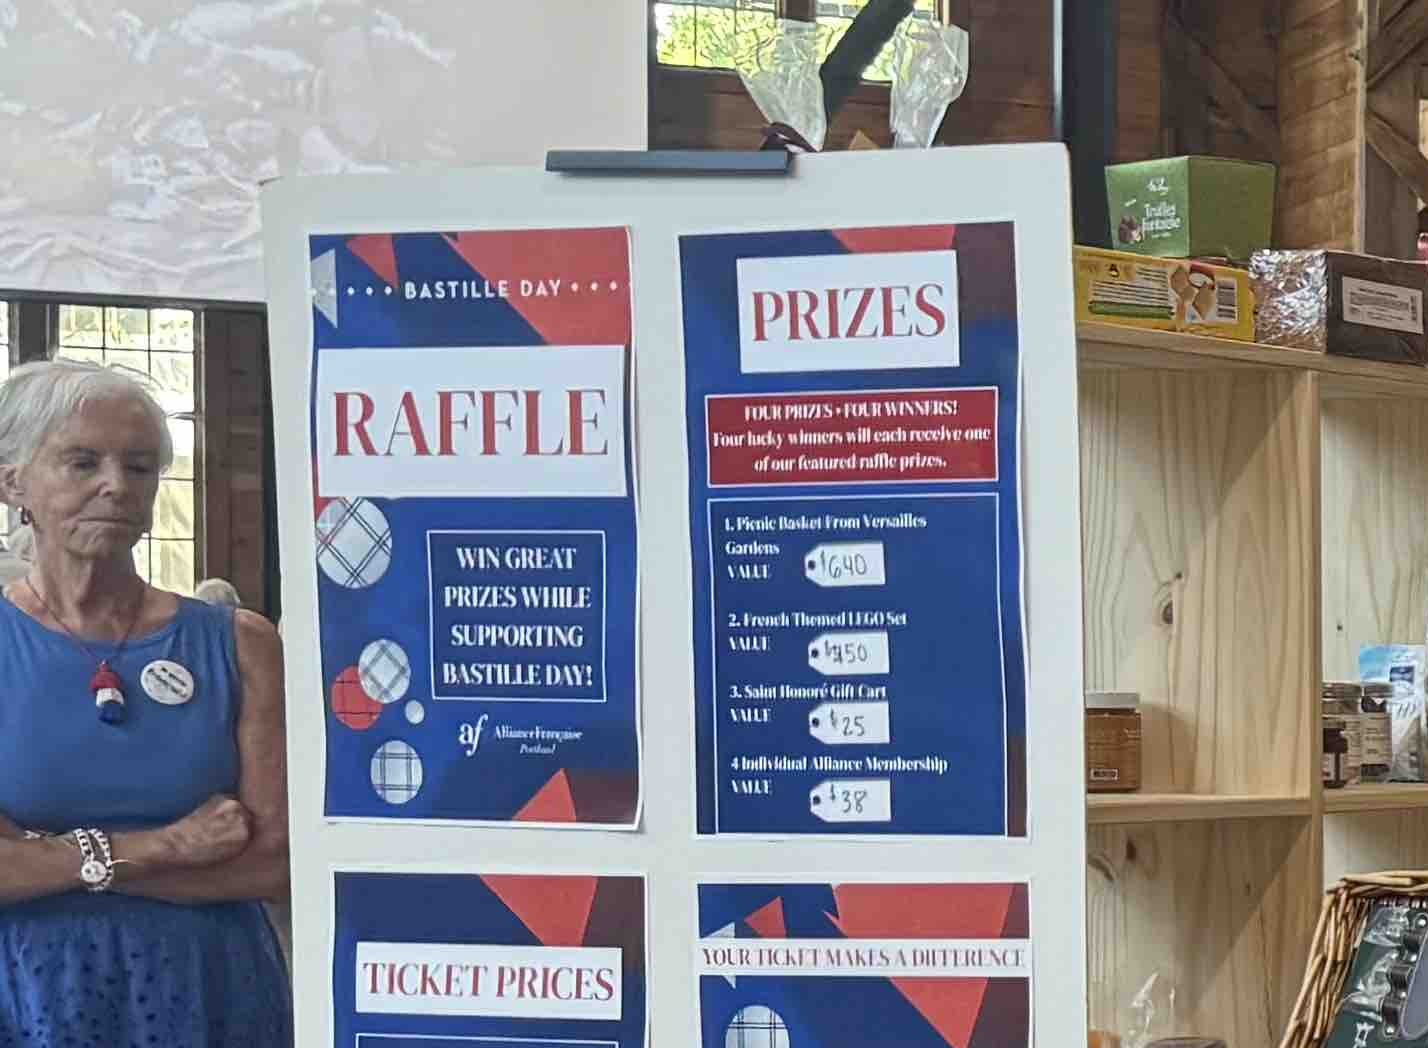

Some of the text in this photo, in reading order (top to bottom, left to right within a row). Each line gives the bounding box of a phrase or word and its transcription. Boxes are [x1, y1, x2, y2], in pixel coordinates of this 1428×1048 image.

[404, 279, 561, 299] BASTILLE DAY
[751, 283, 946, 342] PRIZES
[744, 400, 958, 422] FOUR PRIZES FOUR WINNERS!
[333, 388, 609, 457] RAFFLE
[713, 425, 992, 451] Four lucky winners will each receive one
[754, 452, 947, 473] of our featured raffle prizes.
[725, 513, 927, 531] 1. Picnic Basket From Versailles
[456, 547, 576, 570] WIN GREAT
[725, 541, 780, 556] Gardens
[727, 564, 771, 580] VALUE
[444, 586, 592, 609] PRIZES WHILE
[728, 611, 908, 628] 2. French Themed LEGO Set
[450, 624, 584, 648] SUPPORTING
[728, 636, 771, 652] VALUE
[443, 663, 593, 687] BASTILLE DAY!
[729, 685, 742, 700] 3.
[744, 684, 777, 699] Saint
[779, 682, 826, 699] Honoré
[830, 684, 855, 699] Gift
[730, 707, 773, 722] VALUE
[731, 756, 949, 775] 4 Individual Alliance Membership
[730, 779, 773, 795] VALUE
[702, 948, 1026, 969] YOUR TICKET MAKES A DIFFERENCE
[363, 962, 615, 1002] TICKET PRICES
